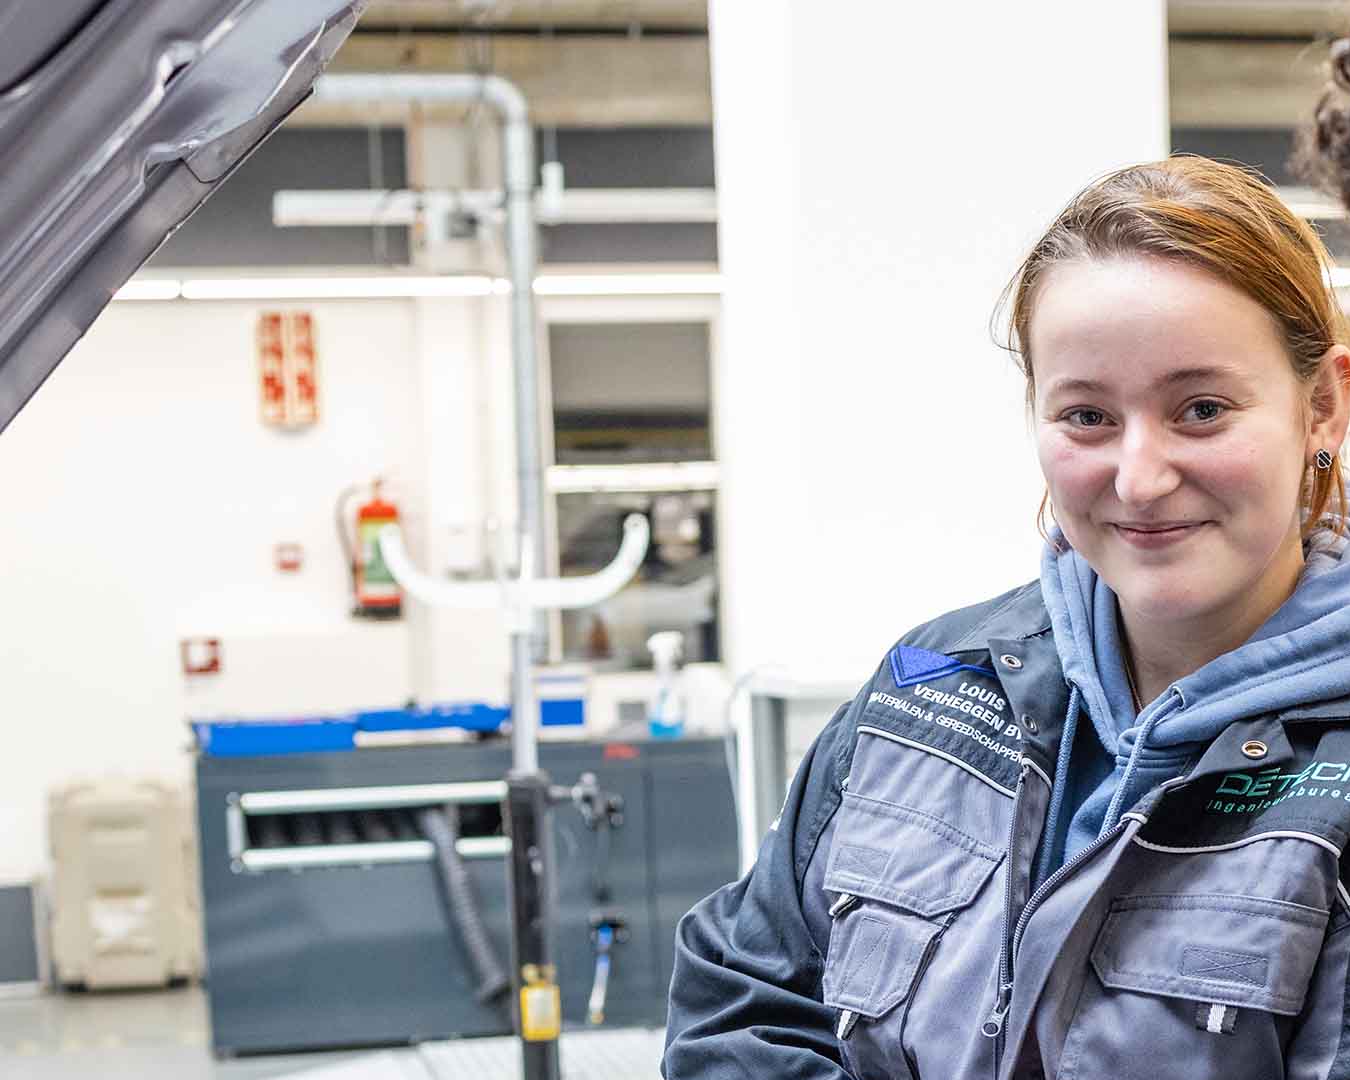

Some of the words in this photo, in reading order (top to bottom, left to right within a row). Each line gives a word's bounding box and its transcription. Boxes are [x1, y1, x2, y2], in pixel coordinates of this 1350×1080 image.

[914, 684, 1006, 731] VERHEGGEN
[958, 682, 1007, 712] LOUIS
[924, 712, 934, 722] &
